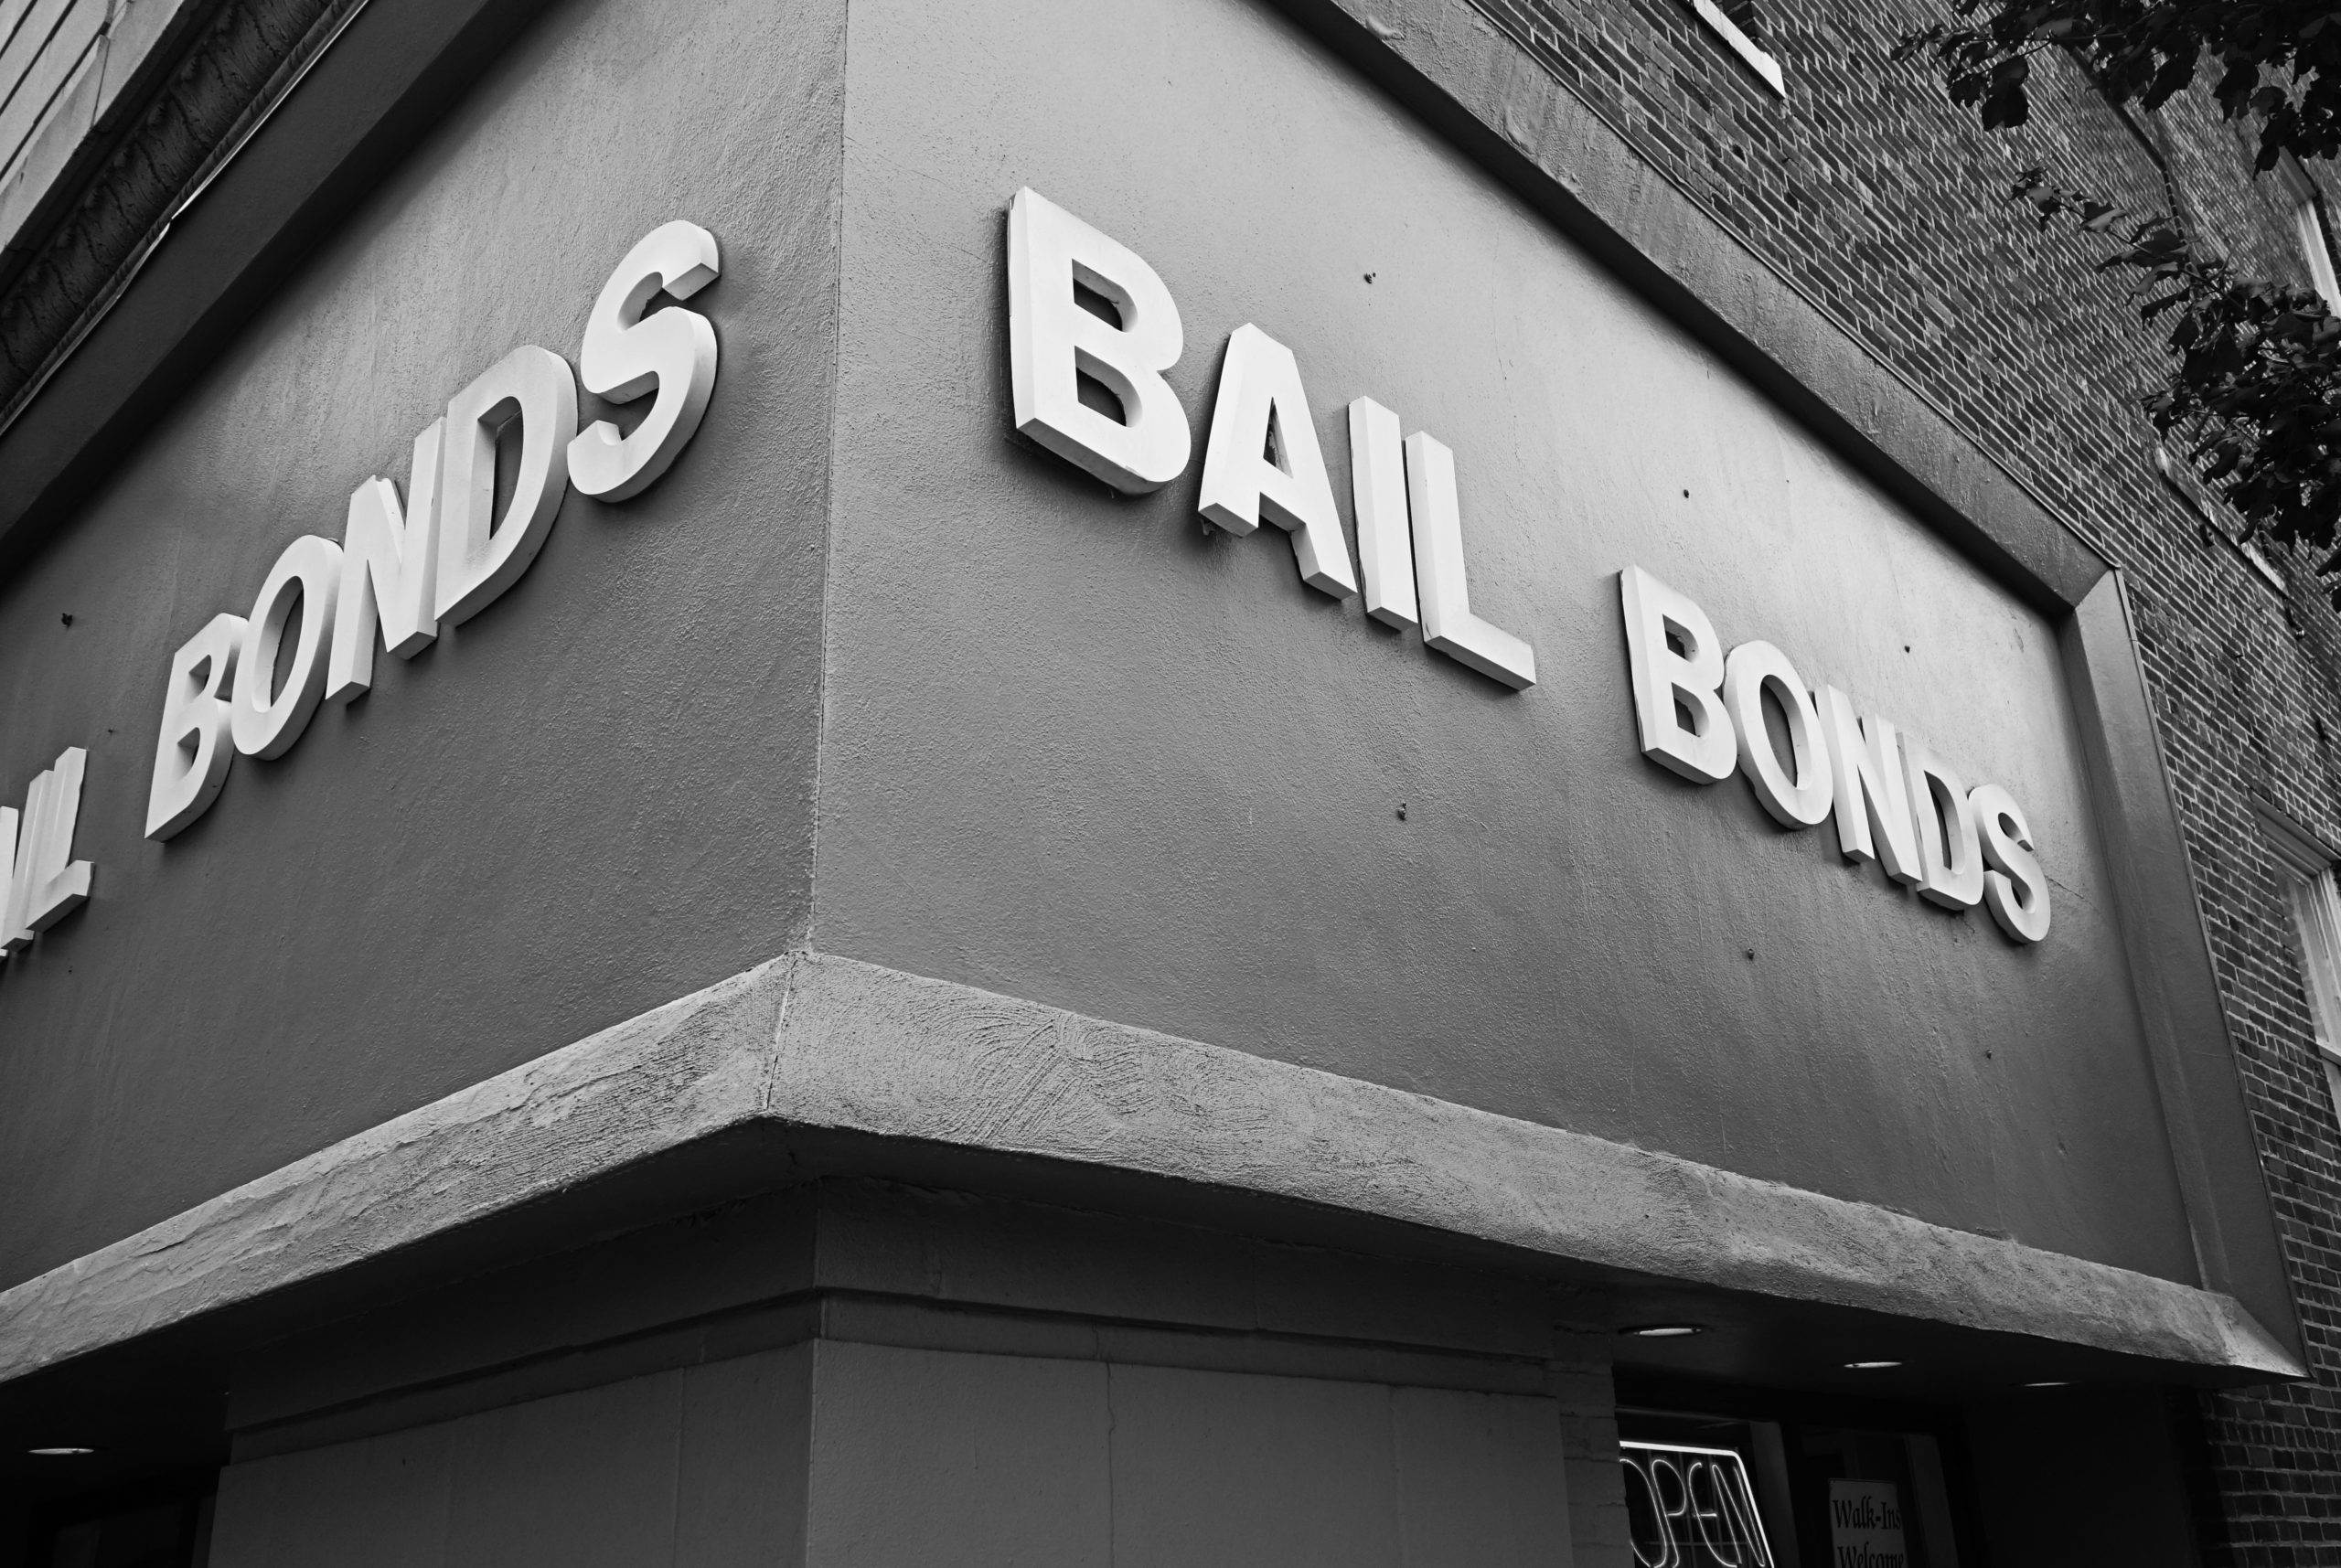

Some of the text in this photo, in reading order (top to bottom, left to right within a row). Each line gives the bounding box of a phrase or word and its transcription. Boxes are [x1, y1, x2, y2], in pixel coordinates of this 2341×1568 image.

[144, 219, 721, 843] BONDS
[1006, 186, 2052, 944] BAIL BONDS
[1832, 1495, 1902, 1531] Walk-Ins
[1837, 1541, 1905, 1568] Welcome
